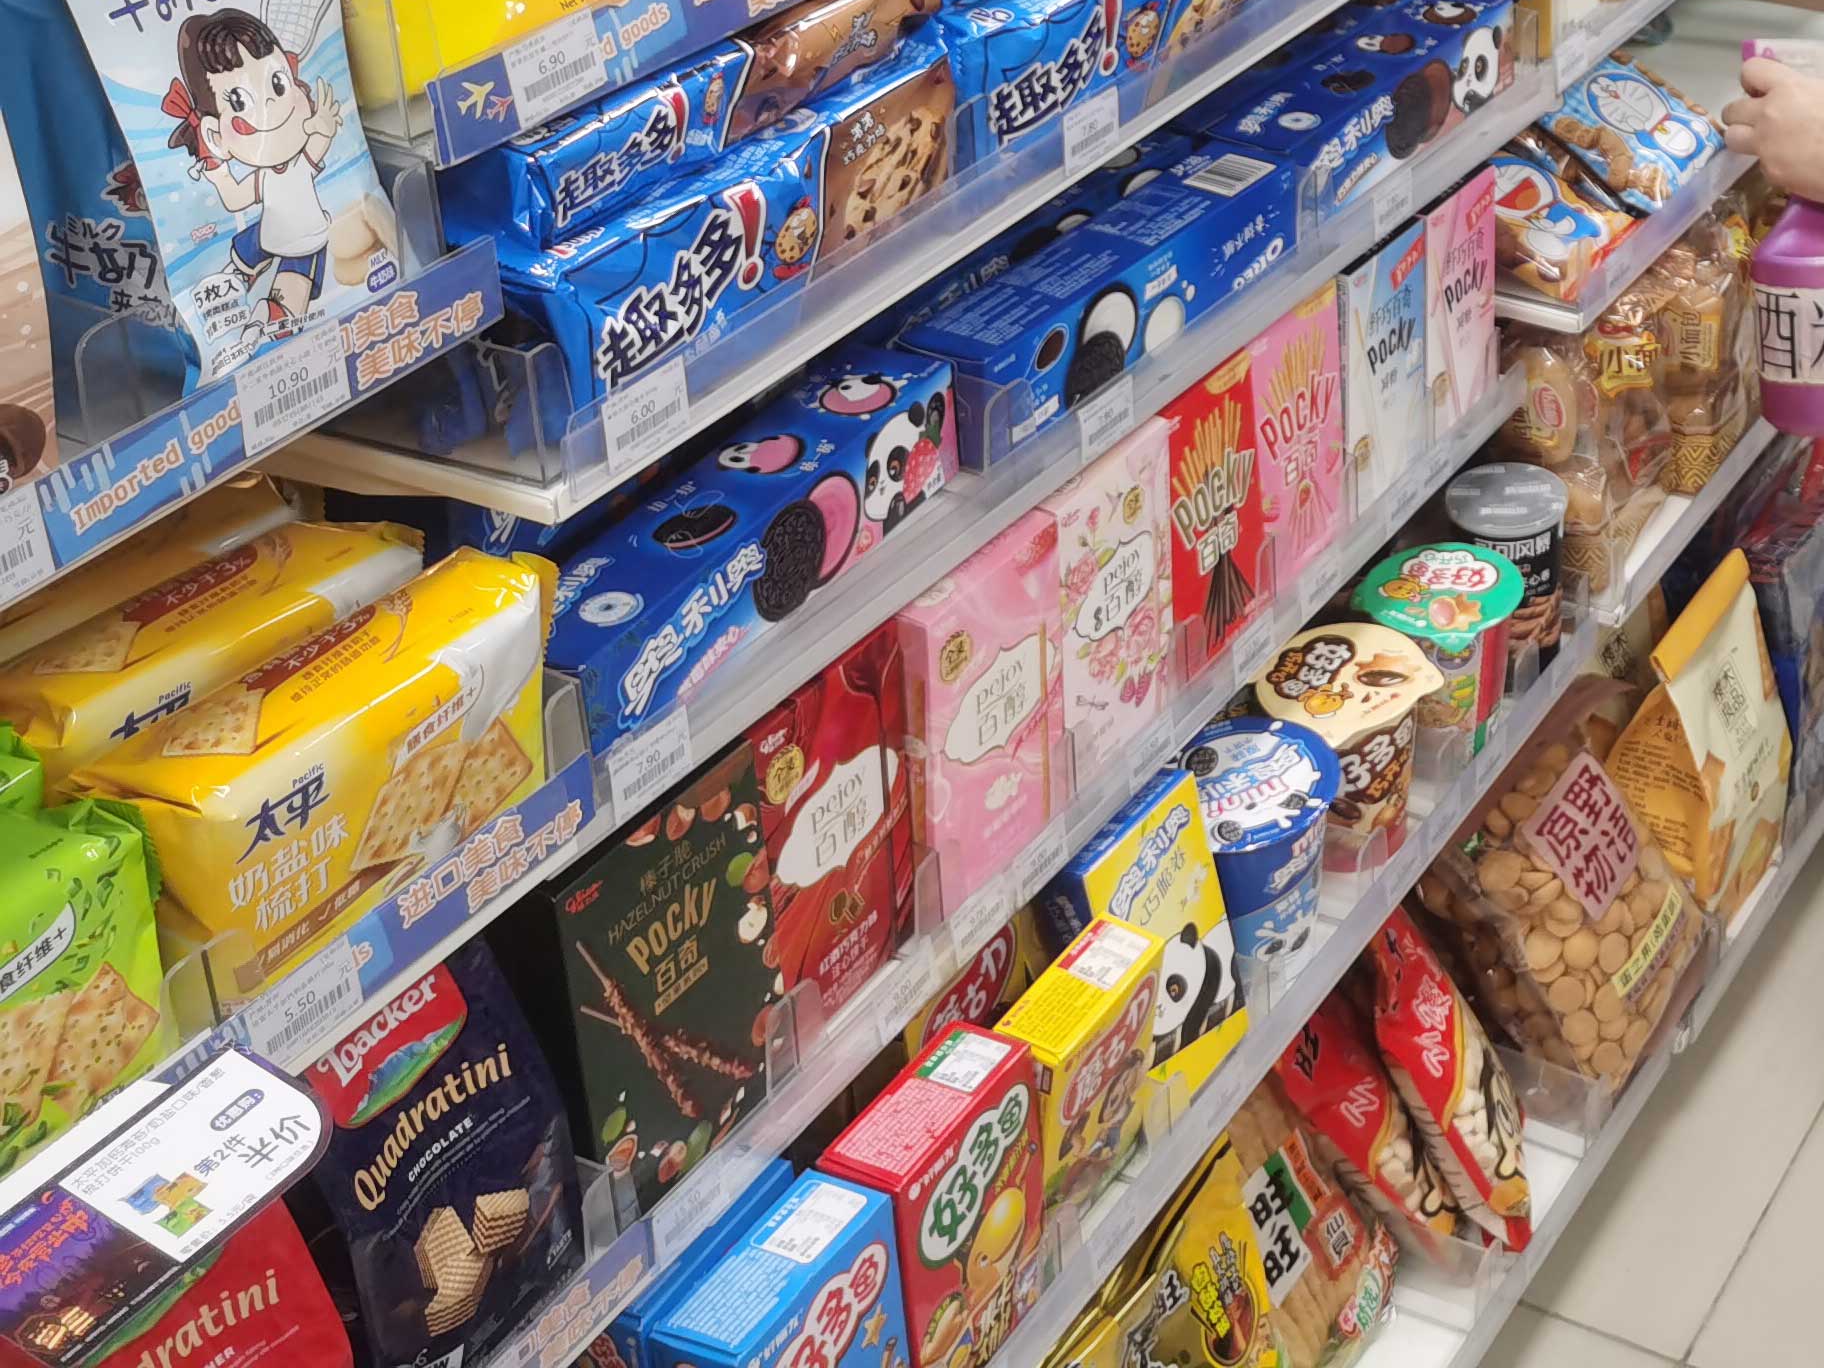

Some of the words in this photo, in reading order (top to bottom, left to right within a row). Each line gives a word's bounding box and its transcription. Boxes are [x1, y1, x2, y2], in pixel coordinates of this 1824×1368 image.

[620, 2, 671, 49] goods
[538, 50, 567, 74] 6.90
[195, 279, 238, 308] 5枚入
[357, 291, 486, 390] 美味不停
[268, 368, 309, 401] 10.90
[630, 401, 657, 425] 6.00
[71, 446, 182, 533] Imported
[190, 403, 241, 452] good
[158, 682, 192, 704] Pacific
[292, 762, 325, 787] Pacific
[636, 750, 661, 778] 7.90
[228, 813, 351, 911] 奶盐味
[398, 814, 524, 928] 进口美食
[468, 799, 583, 914] 美味不停
[255, 856, 338, 931] 梳打
[608, 873, 683, 945] HAZELNUT
[681, 836, 728, 885] CRUSH
[655, 937, 698, 994] 百奇
[285, 990, 316, 1020] 5.50
[317, 973, 440, 1087] Loacker
[194, 1132, 248, 1177] 第2件
[236, 1113, 311, 1169] 半价
[353, 1044, 513, 1212] Quadratini
[407, 1115, 475, 1184] CHOCOLATE
